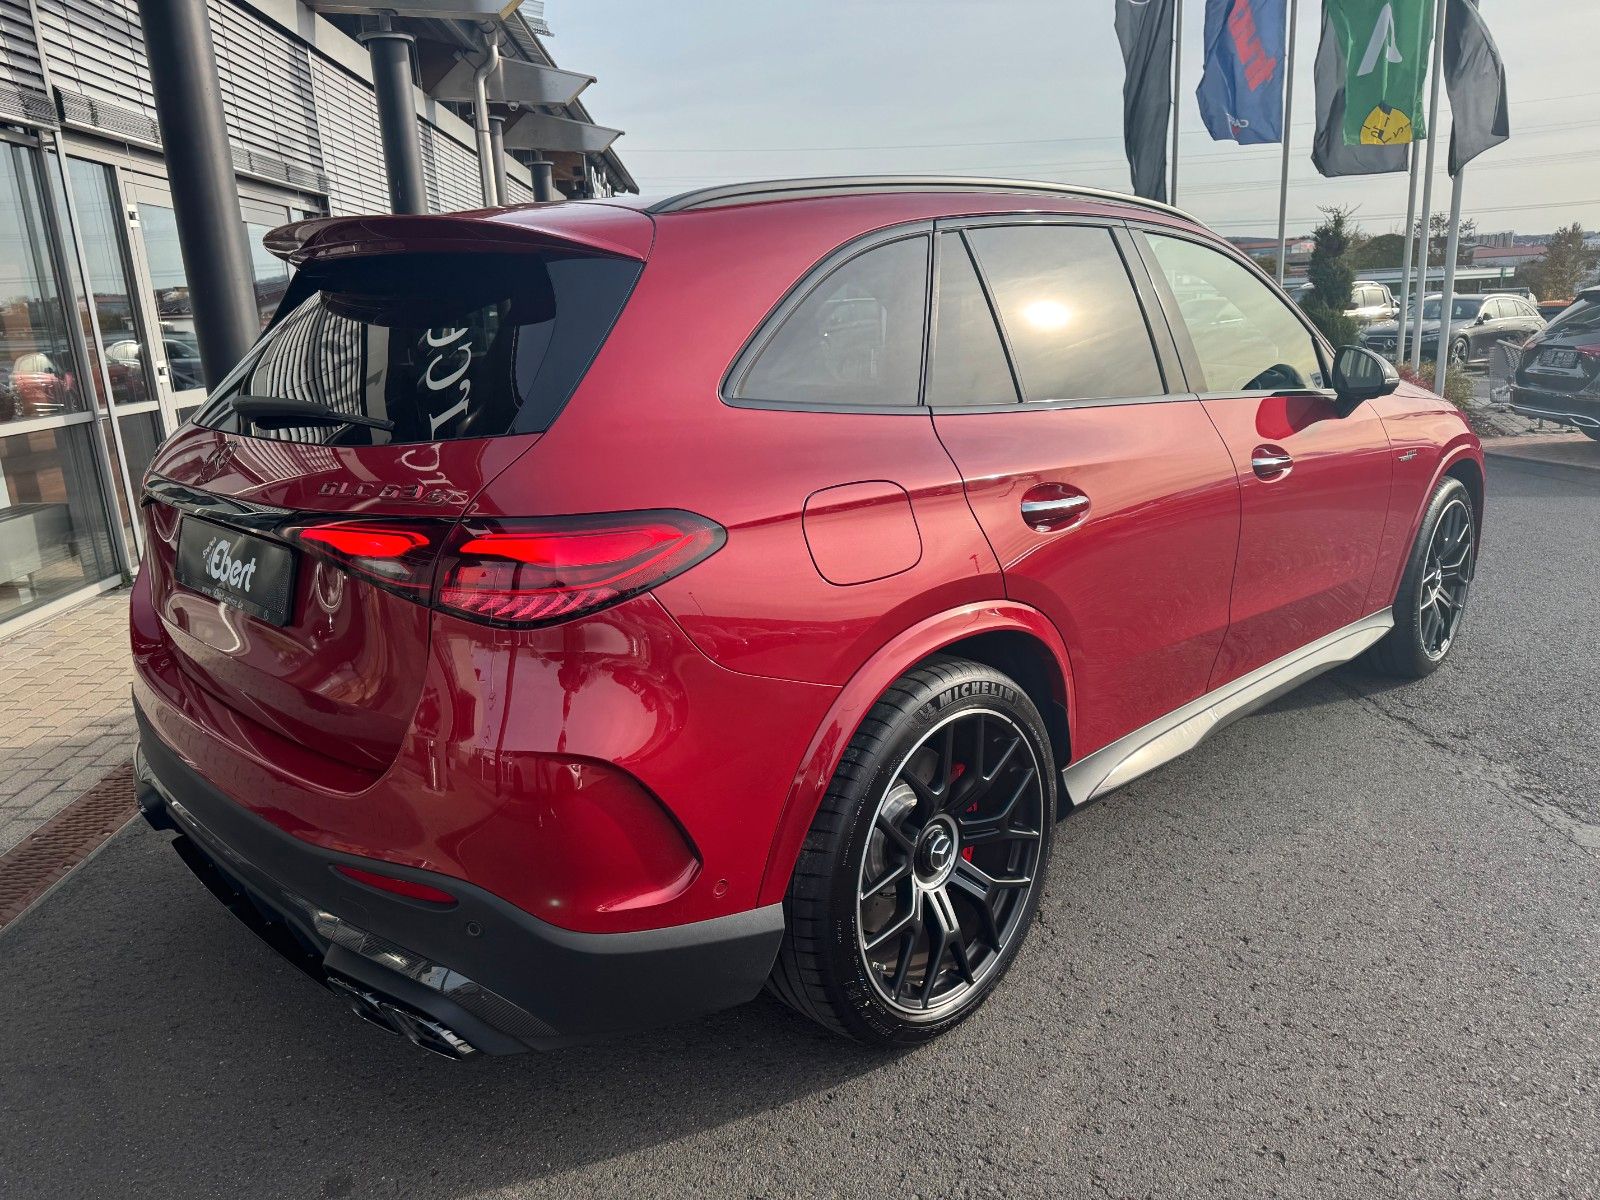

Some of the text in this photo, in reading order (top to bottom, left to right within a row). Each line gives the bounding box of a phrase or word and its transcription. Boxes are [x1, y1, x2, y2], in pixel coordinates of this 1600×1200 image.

[317, 482, 375, 497] GLC
[210, 539, 257, 593] Ebert
[938, 681, 1015, 708] MICHELIN
